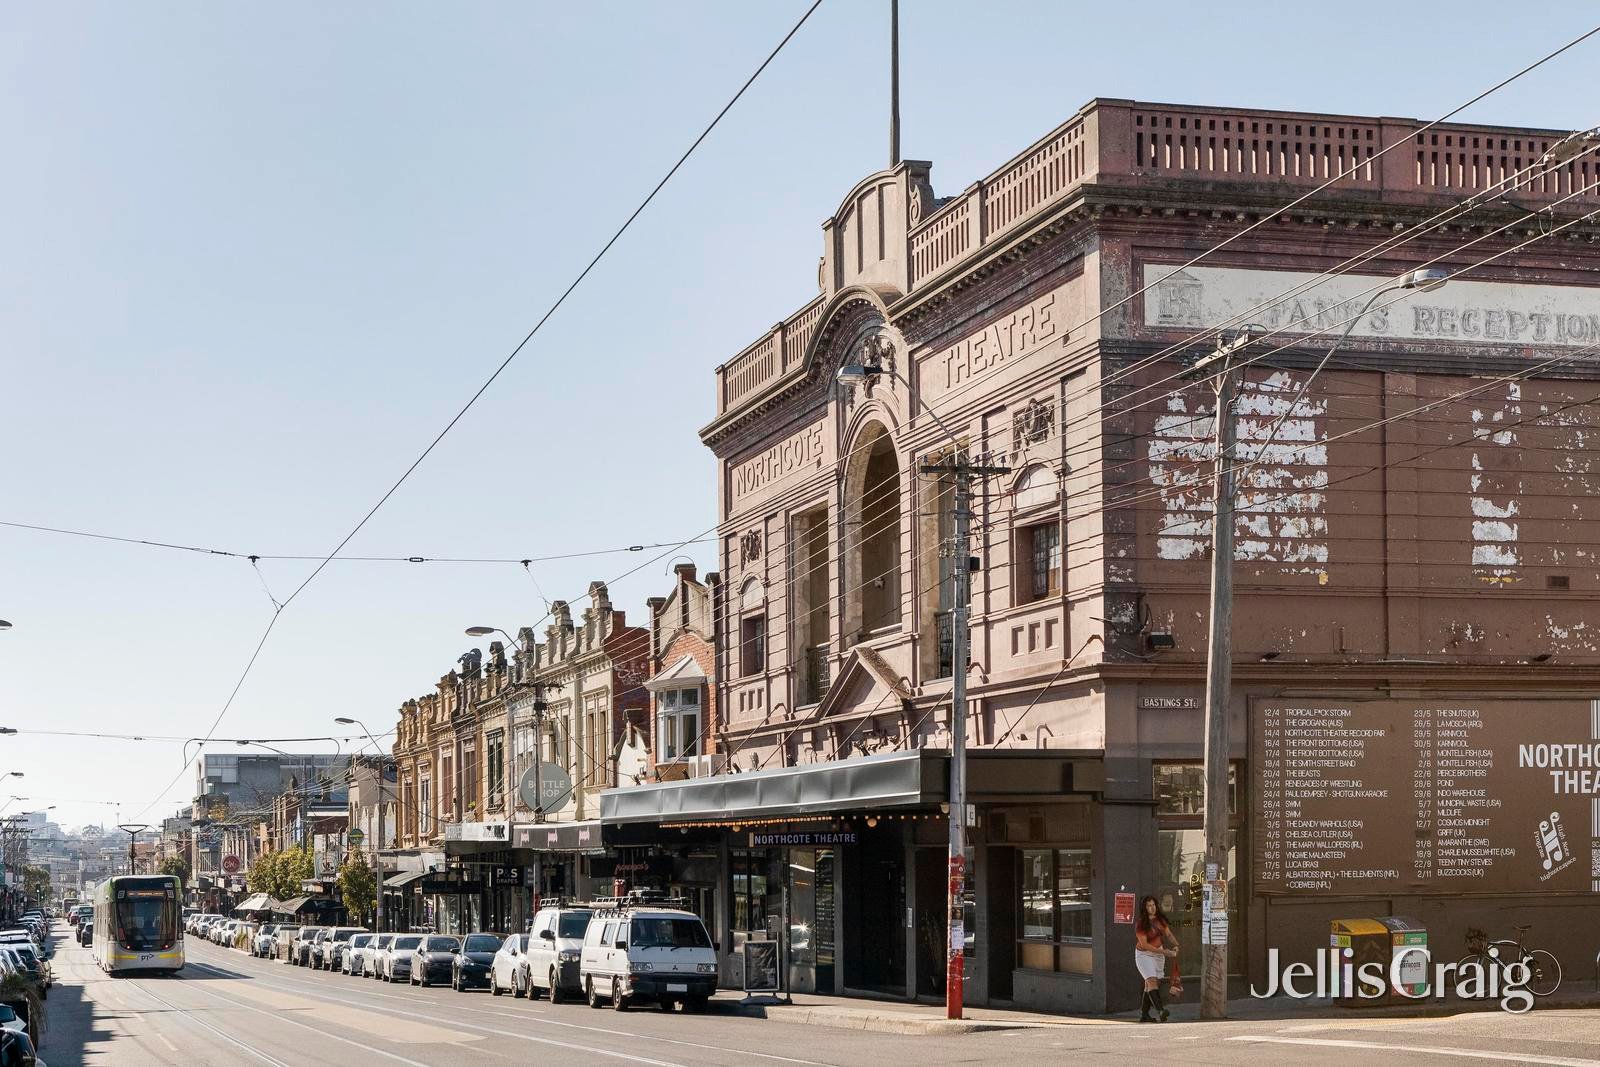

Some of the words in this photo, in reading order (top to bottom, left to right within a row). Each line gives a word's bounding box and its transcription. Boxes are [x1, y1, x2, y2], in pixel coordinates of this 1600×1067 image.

[943, 293, 1056, 389] THEATRE
[736, 421, 824, 497] NORTHCOTE
[1144, 698, 1180, 706] BASTINGS
[1468, 710, 1479, 718] (UK)
[1328, 719, 1343, 728] (AUS)
[1467, 720, 1483, 728] (ARG)
[1349, 740, 1364, 748] (USA)
[1349, 750, 1364, 758] (USA)
[1348, 820, 1363, 828] (USA)
[1338, 831, 1353, 839] (USA)
[1454, 829, 1465, 837] (UK)
[754, 834, 810, 844] NORTHCOTE
[814, 833, 856, 843] THEATRE
[1500, 848, 1516, 857] (USA)
[1472, 869, 1484, 877] (UK)
